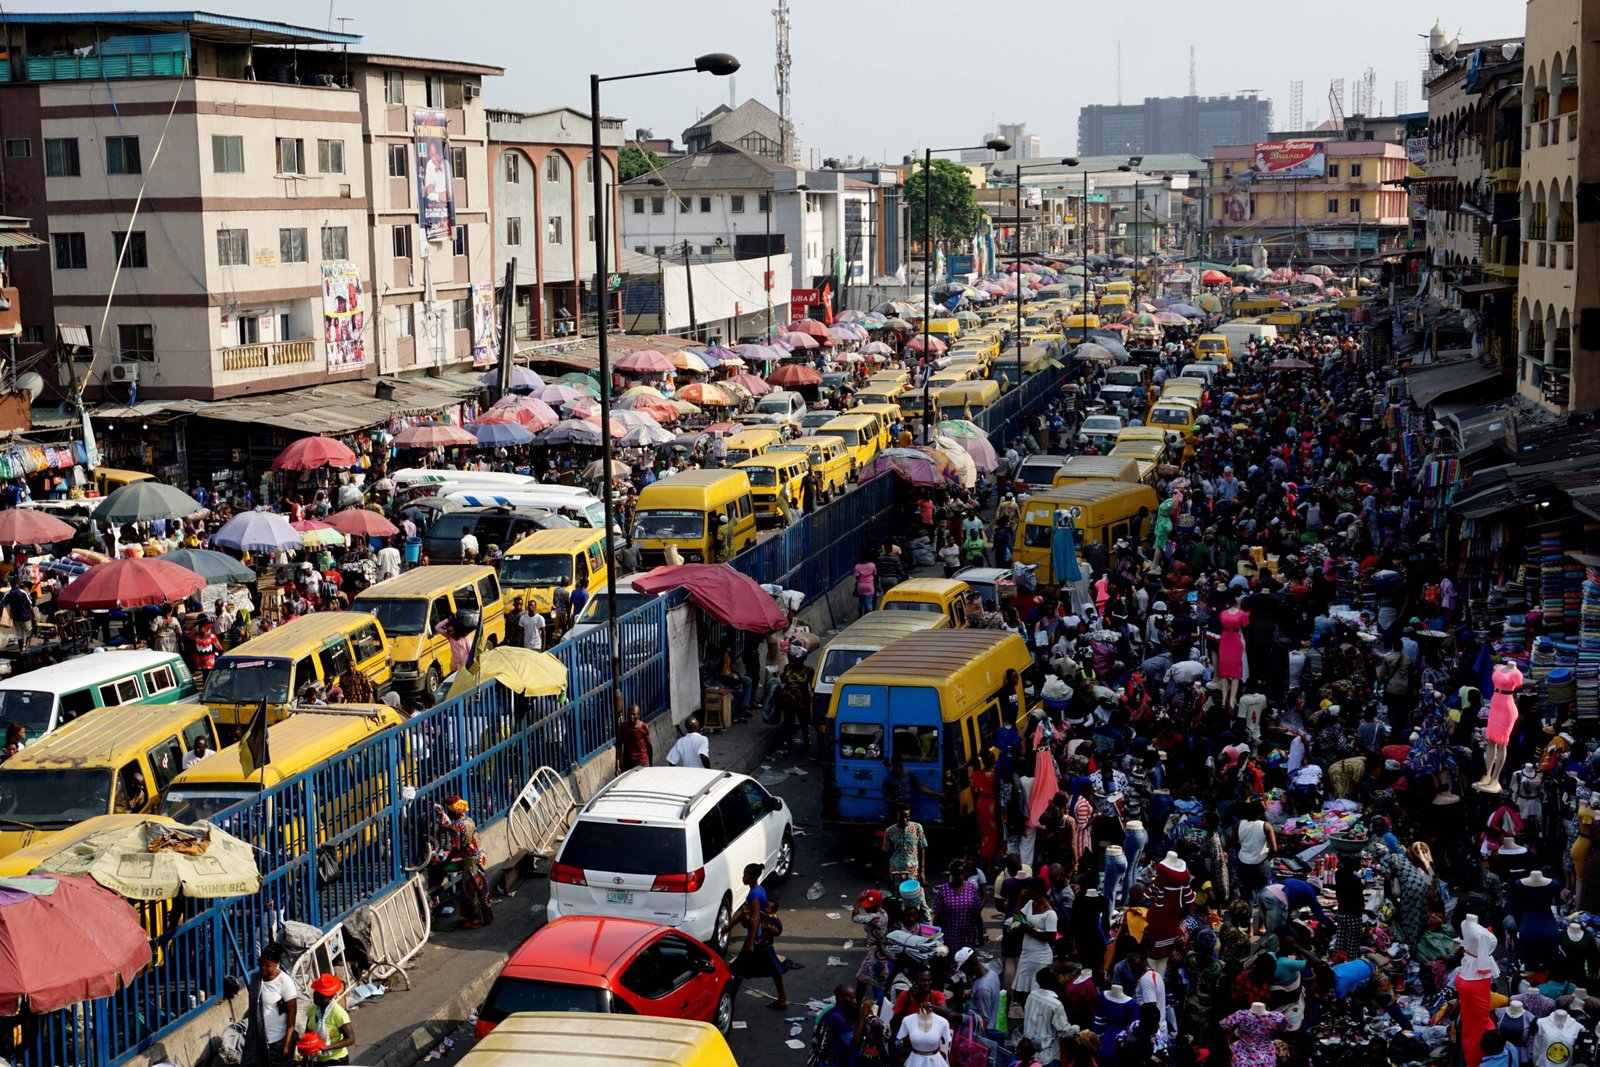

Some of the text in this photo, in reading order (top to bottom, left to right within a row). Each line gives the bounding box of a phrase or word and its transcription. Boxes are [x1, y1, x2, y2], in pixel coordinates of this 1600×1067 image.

[141, 887, 163, 897] BIG
[195, 882, 247, 895] THINK BIG
